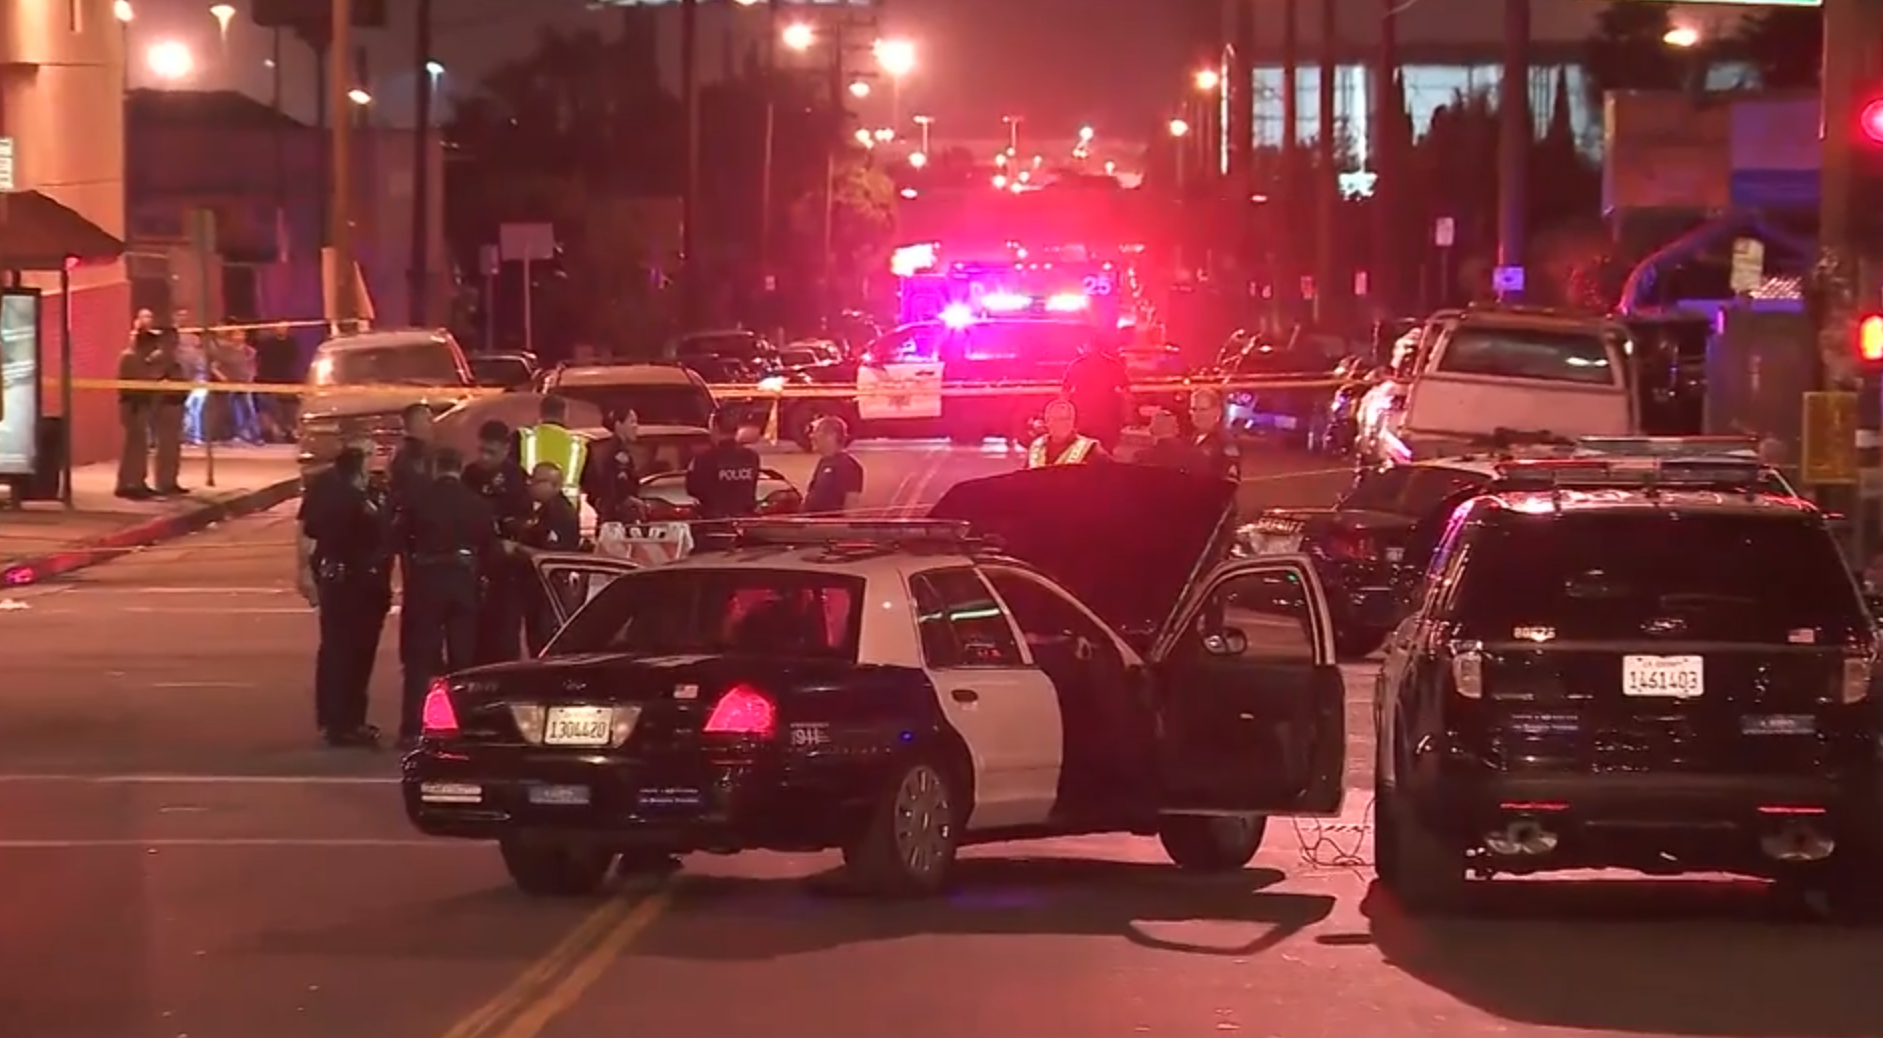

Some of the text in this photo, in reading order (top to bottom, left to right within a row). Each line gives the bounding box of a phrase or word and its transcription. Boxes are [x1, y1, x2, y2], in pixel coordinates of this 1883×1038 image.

[1083, 276, 1110, 295] 25
[718, 467, 753, 481] POLICE
[1629, 671, 1697, 690] 1461403
[550, 721, 606, 738] 1304420
